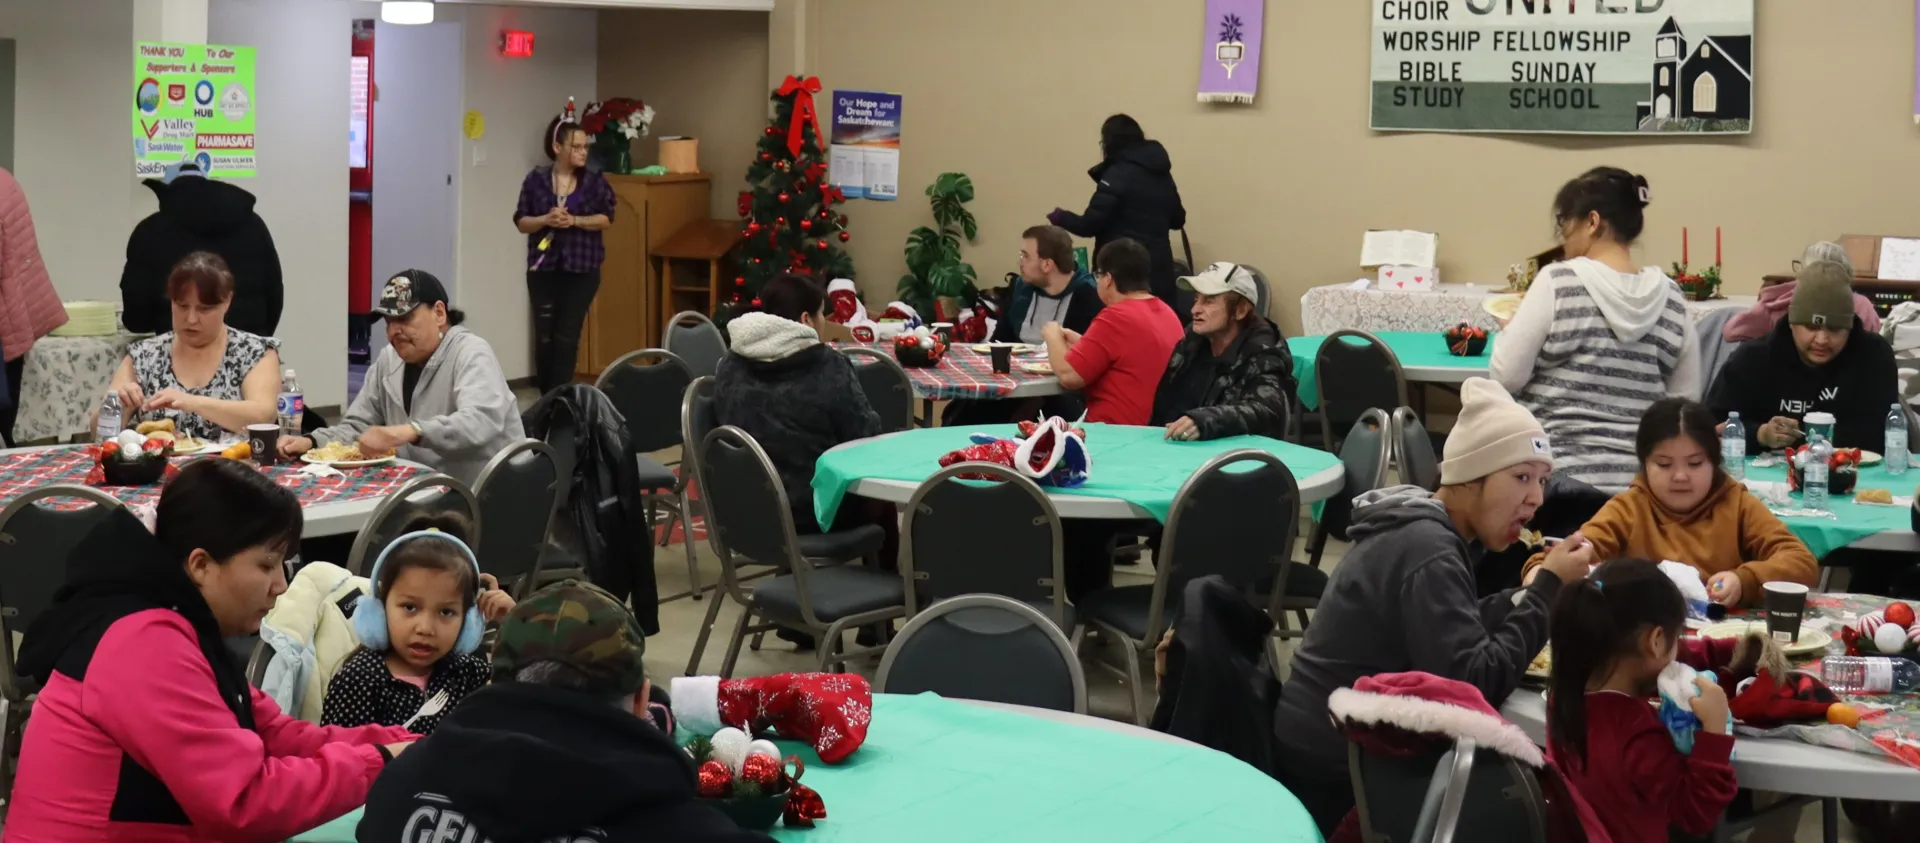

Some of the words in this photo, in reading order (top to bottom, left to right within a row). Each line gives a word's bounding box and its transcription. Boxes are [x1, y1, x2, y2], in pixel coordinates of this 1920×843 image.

[1382, 0, 1449, 20] CHOIR
[1383, 30, 1481, 51] WORSHIP
[1493, 30, 1632, 52] FELLOWSHIP
[140, 45, 167, 56] THANK
[169, 47, 185, 57] YOU
[219, 49, 234, 58] Our
[146, 62, 187, 74] Supporters
[201, 63, 235, 74] Sponsors
[1400, 61, 1462, 82] BIBLE
[1511, 62, 1596, 83] SUNDAY
[839, 98, 854, 106] Our
[856, 99, 877, 109] Hope
[879, 100, 895, 109] and
[1393, 86, 1465, 107] STUDY
[1509, 88, 1600, 109] SCHOOL
[194, 108, 214, 118] HUB
[846, 106, 872, 117] Dream
[874, 108, 886, 117] for
[164, 118, 195, 132] Valley
[197, 135, 253, 147] PHARMASAVE
